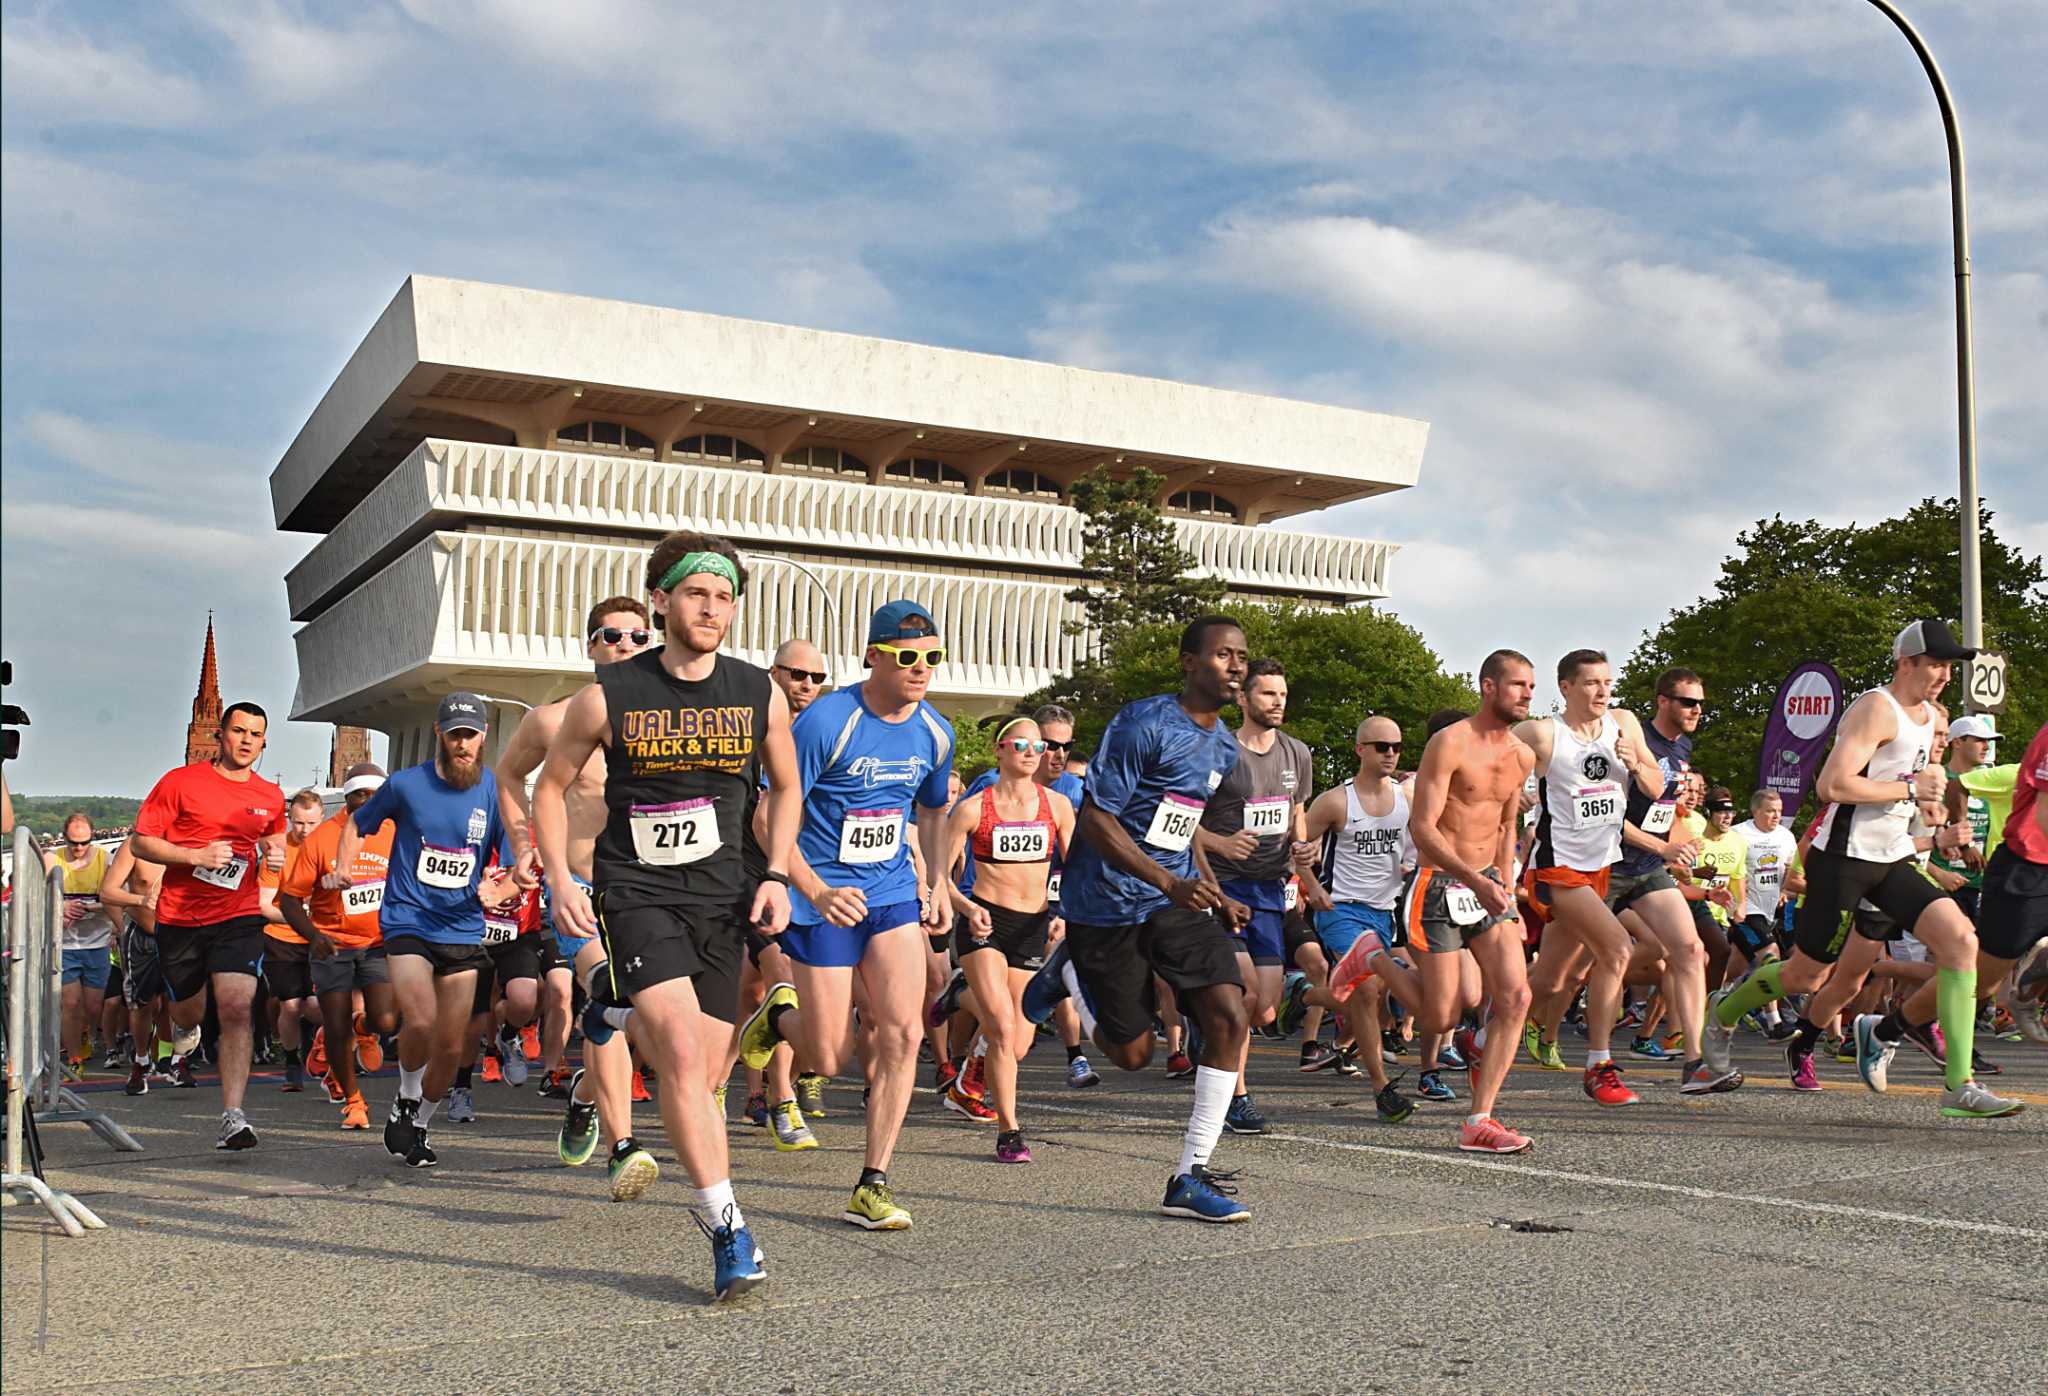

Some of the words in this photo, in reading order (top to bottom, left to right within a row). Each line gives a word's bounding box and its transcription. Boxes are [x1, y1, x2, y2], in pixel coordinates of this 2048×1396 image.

[1974, 663, 2001, 698] 20
[1788, 695, 1832, 716] START
[622, 706, 753, 741] UALBANY
[625, 739, 683, 757] TRACK
[686, 738, 702, 754] &
[707, 737, 753, 754] FIELD
[1252, 808, 1282, 826] 7715
[1580, 798, 1615, 818] 3651
[653, 820, 699, 848] 272
[849, 824, 896, 849] 4588
[999, 834, 1043, 853] 8329
[1354, 828, 1402, 843] COLONIE
[1357, 840, 1396, 856] POLICE
[425, 856, 470, 878] 9452
[348, 888, 382, 907] 8427
